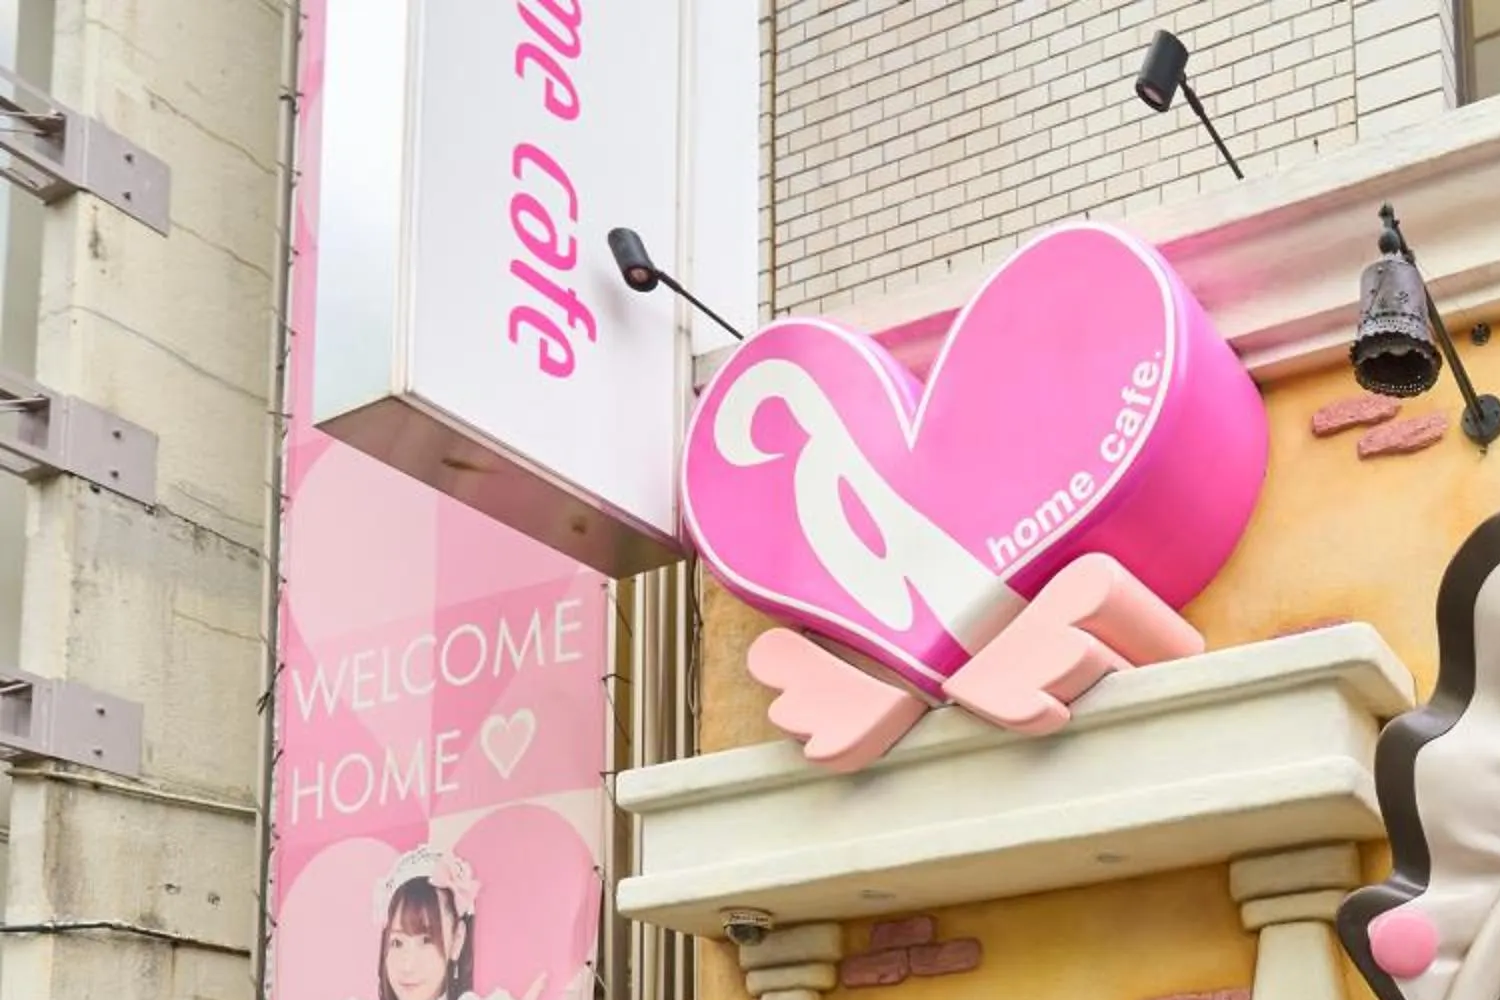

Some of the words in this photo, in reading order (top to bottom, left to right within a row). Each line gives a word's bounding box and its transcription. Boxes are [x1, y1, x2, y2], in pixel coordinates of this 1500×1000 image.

[509, 143, 596, 378] cafe
[987, 469, 1096, 568] home
[1099, 349, 1163, 464] cafe.
[292, 600, 584, 722] WELCOME
[292, 728, 462, 825] HOME
